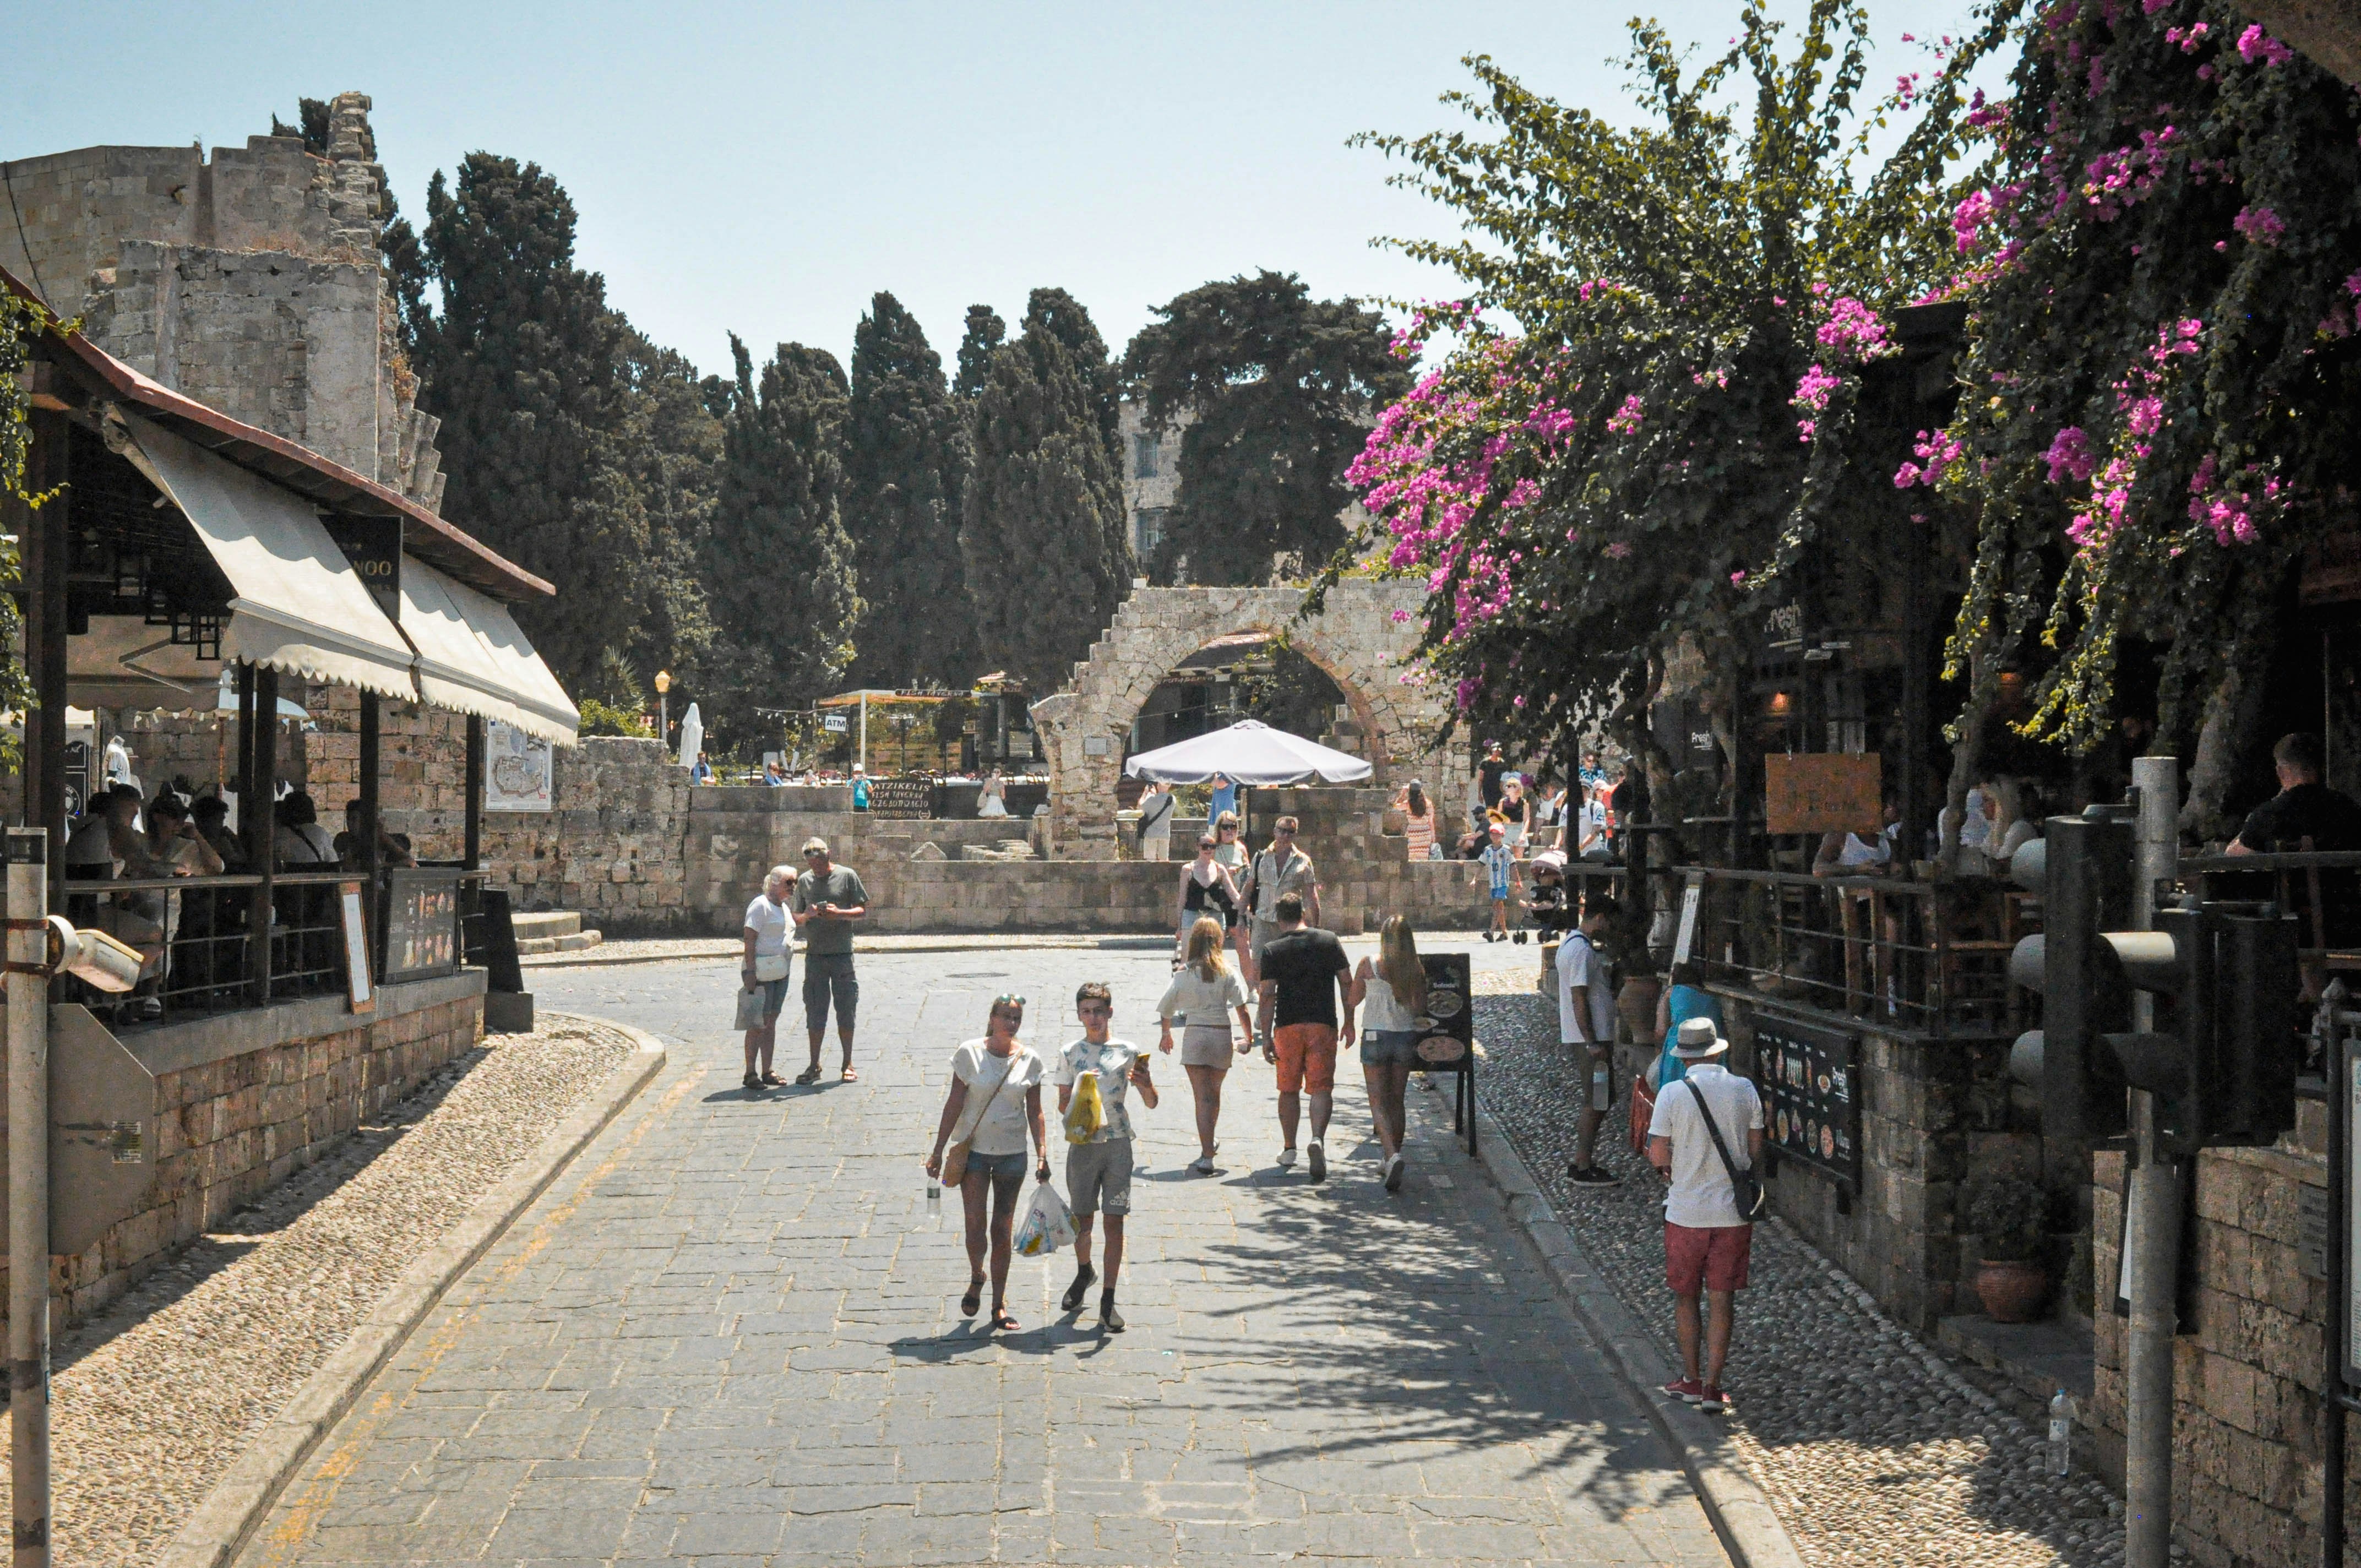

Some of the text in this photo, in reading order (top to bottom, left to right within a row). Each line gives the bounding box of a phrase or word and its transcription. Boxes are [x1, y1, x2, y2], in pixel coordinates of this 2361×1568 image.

[872, 782, 931, 792] ATZIKELIS
[893, 791, 923, 800] TAVERNA
[1492, 863, 1499, 872] 10
[1109, 1199, 1130, 1208] adid
